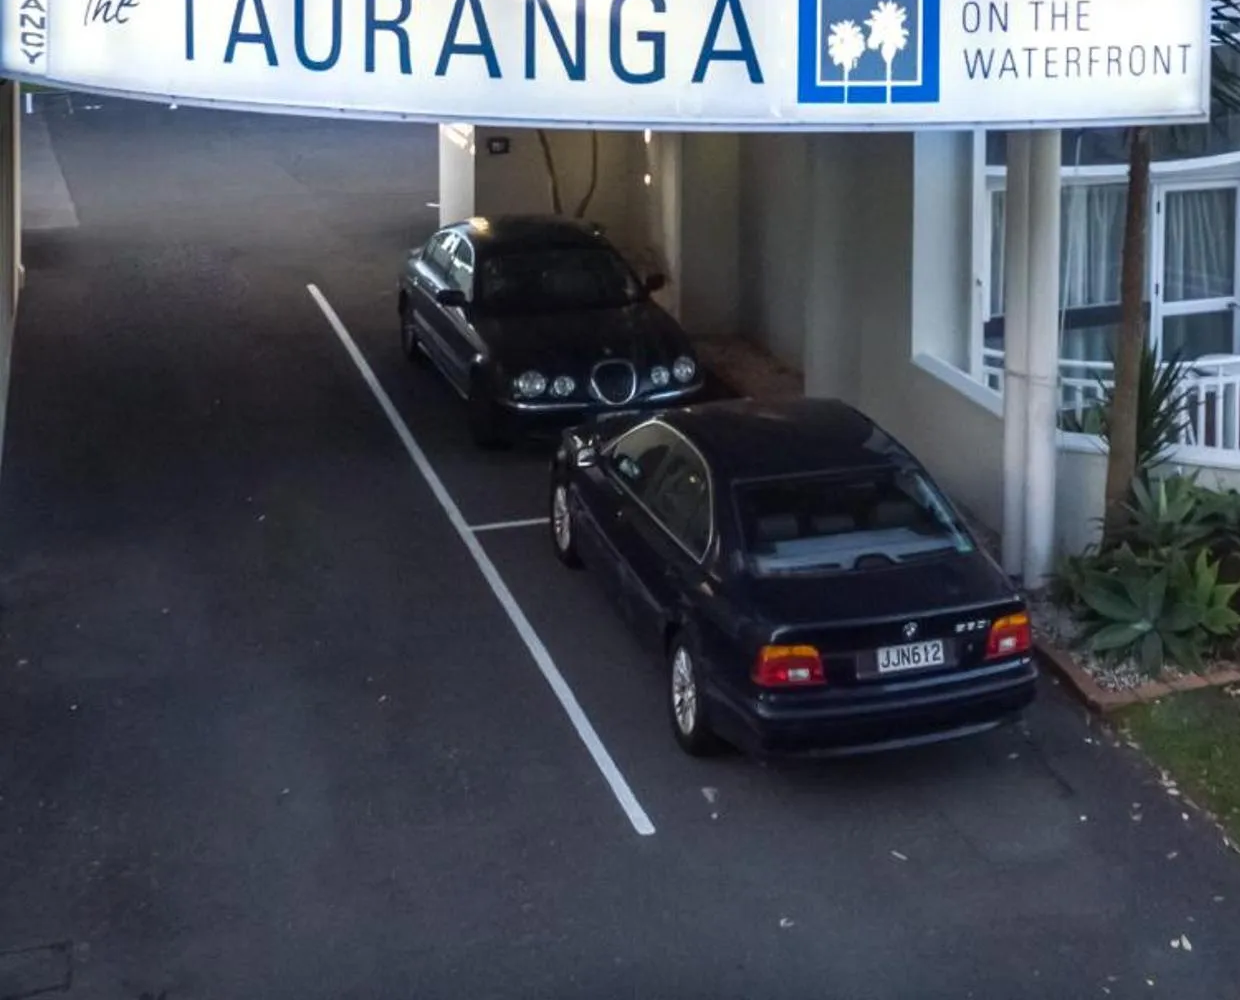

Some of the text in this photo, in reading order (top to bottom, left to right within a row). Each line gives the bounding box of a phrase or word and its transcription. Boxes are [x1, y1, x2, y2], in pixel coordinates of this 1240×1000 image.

[961, 0, 1091, 33] ON THE
[963, 43, 1192, 80] WATERFRONT
[881, 643, 941, 668] JJN612
